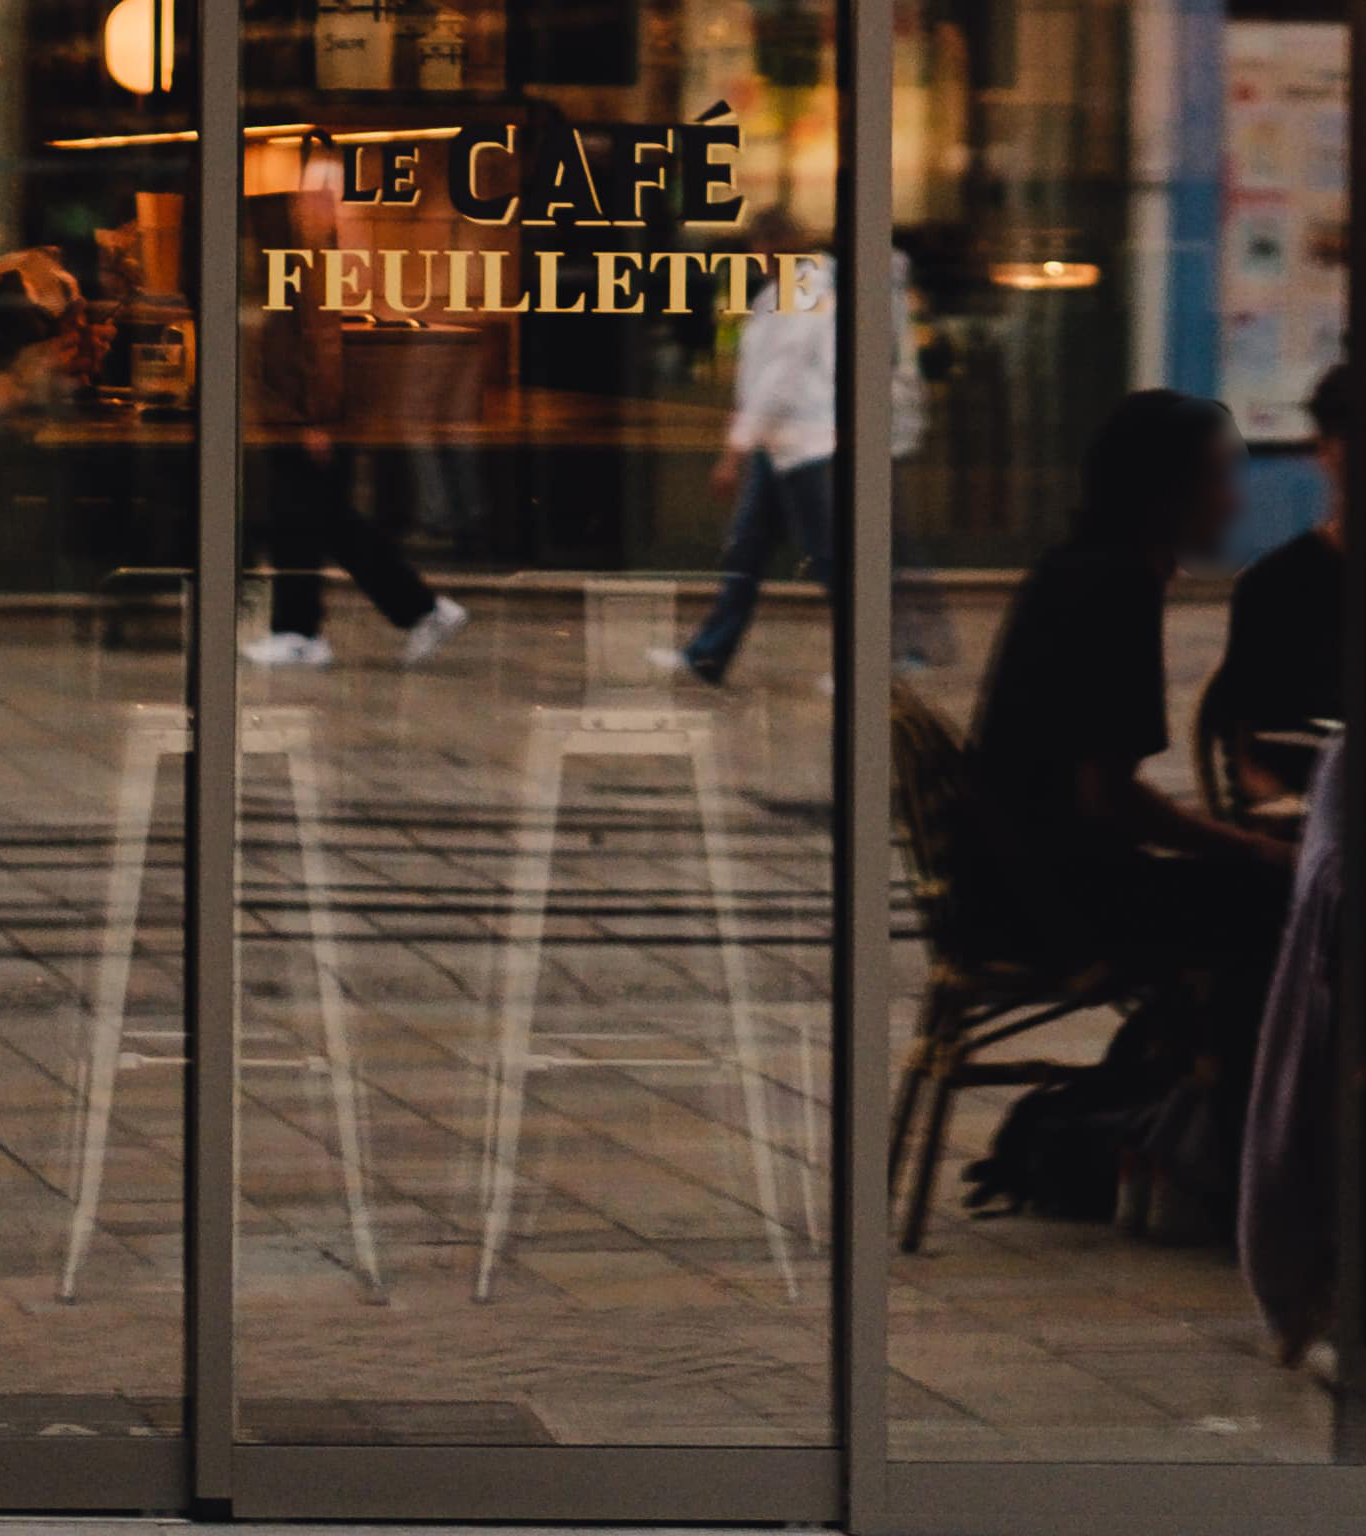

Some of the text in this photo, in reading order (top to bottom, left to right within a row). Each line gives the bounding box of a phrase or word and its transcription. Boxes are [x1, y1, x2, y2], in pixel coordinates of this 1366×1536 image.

[341, 100, 746, 227] LE CAFÉ
[261, 248, 829, 315] FEUILLETTE
